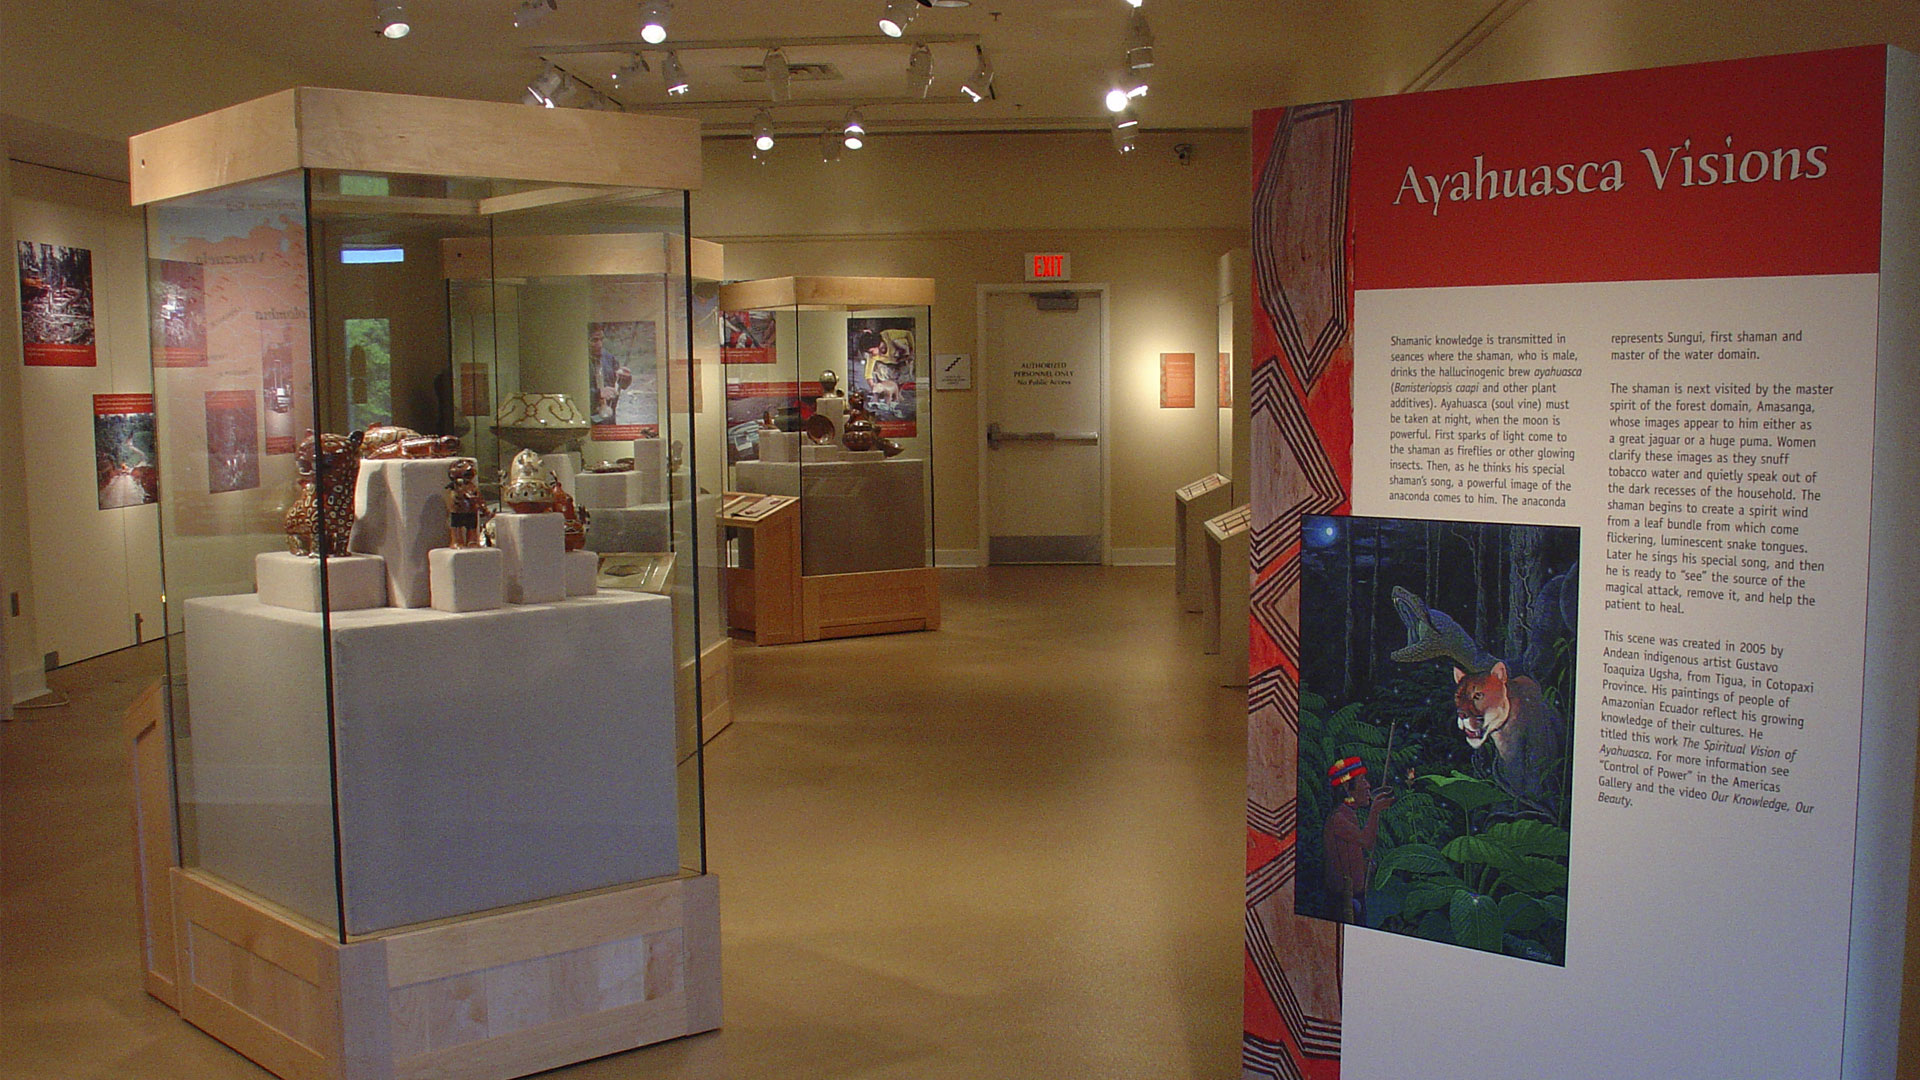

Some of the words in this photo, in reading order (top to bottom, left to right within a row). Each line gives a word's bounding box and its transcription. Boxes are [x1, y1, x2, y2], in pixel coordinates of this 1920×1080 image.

[1393, 155, 1624, 215] Ayahuasca
[1642, 136, 1828, 189] Visions
[1034, 255, 1064, 277] EXIT
[1391, 335, 1432, 346] Shamanic
[1435, 335, 1483, 348] knowledge
[1487, 334, 1494, 345] is
[1498, 333, 1552, 344] transmitted
[1557, 333, 1566, 343] in
[1611, 333, 1663, 346] represents
[1667, 331, 1705, 345] Sungui,
[1710, 331, 1733, 342] first
[1737, 331, 1777, 342] shaman
[1782, 330, 1802, 342] and
[1391, 354, 1424, 362] seances
[1428, 351, 1454, 361] where
[1458, 350, 1473, 361] the
[1476, 350, 1513, 361] shaman,
[1518, 350, 1537, 360] who
[1541, 349, 1548, 360] is
[1553, 349, 1577, 361] male,
[1611, 350, 1645, 360] master
[1649, 348, 1660, 360] of
[1663, 348, 1680, 360] the
[1685, 350, 1714, 360] water
[1718, 348, 1760, 360] domain.
[1391, 367, 1417, 377] drinks
[1421, 366, 1435, 377] the
[1439, 366, 1504, 379] hallucinogenic
[1508, 366, 1530, 377] brew
[1534, 366, 1582, 379] ayahuasca
[1391, 382, 1452, 395] (Banisteriopsis
[1455, 382, 1480, 395] caapi
[1482, 382, 1499, 393] and
[1503, 382, 1528, 393] other
[1532, 382, 1556, 395] plant
[1390, 397, 1437, 411] additives).
[1440, 398, 1487, 411] Ayahuasca
[1491, 398, 1514, 411] (soul
[1518, 398, 1541, 412] vine)
[1546, 400, 1569, 409] must
[1610, 399, 1636, 413] spirit
[1640, 399, 1651, 410] of
[1655, 400, 1672, 411] the
[1676, 399, 1706, 411] forest
[1710, 400, 1752, 413] domain,
[1757, 401, 1815, 415] Amasanga,
[1610, 416, 1640, 427] whose
[1645, 416, 1680, 430] images
[1684, 420, 1719, 431] appear
[1723, 419, 1734, 429] to
[1739, 417, 1758, 429] him
[1763, 418, 1796, 430] either
[1800, 421, 1812, 430] as
[1390, 429, 1431, 440] powerful.
[1435, 429, 1455, 440] First
[1458, 430, 1486, 442] sparks
[1490, 430, 1500, 440] of
[1503, 430, 1525, 444] light
[1528, 433, 1553, 442] come
[1557, 432, 1567, 442] to
[1609, 449, 1641, 463] clarify
[1645, 450, 1673, 462] these
[1677, 450, 1712, 465] images
[1717, 454, 1728, 463] as
[1733, 452, 1757, 467] they
[1761, 453, 1790, 464] snuff
[1390, 459, 1423, 470] insects.
[1427, 460, 1450, 472] Then,
[1468, 461, 1479, 472] he
[1483, 462, 1511, 473] thinks
[1515, 462, 1529, 474] his
[1532, 464, 1565, 476] special
[1389, 491, 1430, 501] anaconda
[1433, 494, 1461, 503] comes
[1464, 494, 1474, 503] to
[1478, 493, 1497, 504] him.
[1502, 494, 1518, 505] The
[1522, 496, 1566, 507] anaconda
[1608, 482, 1624, 494] the
[1628, 483, 1650, 494] dark
[1654, 487, 1696, 496] recesses
[1700, 485, 1712, 497] of
[1715, 486, 1733, 498] the
[1737, 487, 1796, 500] household.
[1801, 489, 1821, 501] The
[1607, 515, 1630, 527] from
[1634, 519, 1640, 527] a
[1644, 517, 1664, 528] leaf
[1667, 518, 1702, 530] bundle
[1706, 519, 1730, 532] from
[1735, 521, 1766, 533] which
[1770, 526, 1799, 535] come
[1607, 531, 1656, 548] flickering,
[1661, 534, 1723, 549] luminescent
[1727, 539, 1756, 551] snake
[1761, 541, 1808, 555] tongues.
[1605, 582, 1643, 595] magical
[1647, 585, 1682, 598] attack,
[1687, 590, 1724, 600] remove
[1729, 589, 1740, 602] it,
[1745, 592, 1764, 602] and
[1769, 592, 1793, 607] help
[1797, 594, 1815, 606] the
[1605, 598, 1641, 610] patient
[1645, 601, 1655, 611] to
[1660, 601, 1684, 614] heal.
[1603, 647, 1639, 660] Andean
[1644, 650, 1698, 665] indigenous
[1703, 656, 1732, 668] artist
[1736, 658, 1778, 672] Gustavo
[1603, 663, 1645, 677] Toaquiza
[1649, 667, 1682, 682] Ugsha,
[1687, 670, 1711, 683] from
[1715, 673, 1746, 688] Tigua,
[1752, 676, 1761, 688] in
[1766, 678, 1814, 694] Cotopaxi
[1603, 679, 1647, 694] Province.
[1652, 684, 1667, 696] His
[1672, 687, 1719, 703] paintings
[1723, 691, 1735, 702] of
[1739, 695, 1774, 708] people
[1779, 697, 1790, 708] of
[1601, 696, 1654, 710] Amazonian
[1659, 701, 1699, 715] Ecuador
[1703, 706, 1737, 720] reflect
[1742, 710, 1757, 722] his
[1761, 714, 1804, 730] growing
[1600, 727, 1627, 741] titled
[1632, 731, 1650, 743] this
[1654, 735, 1678, 746] work
[1683, 737, 1700, 749] The
[1703, 739, 1746, 755] Spiritual
[1751, 745, 1780, 758] Vision
[1785, 749, 1798, 763] of
[1598, 776, 1632, 792] Gallery
[1636, 782, 1654, 793] and
[1658, 784, 1675, 796] the
[1679, 787, 1707, 800] video
[1711, 790, 1729, 802] Our
[1733, 793, 1790, 812] Knowledge,
[1795, 801, 1814, 813] Our
